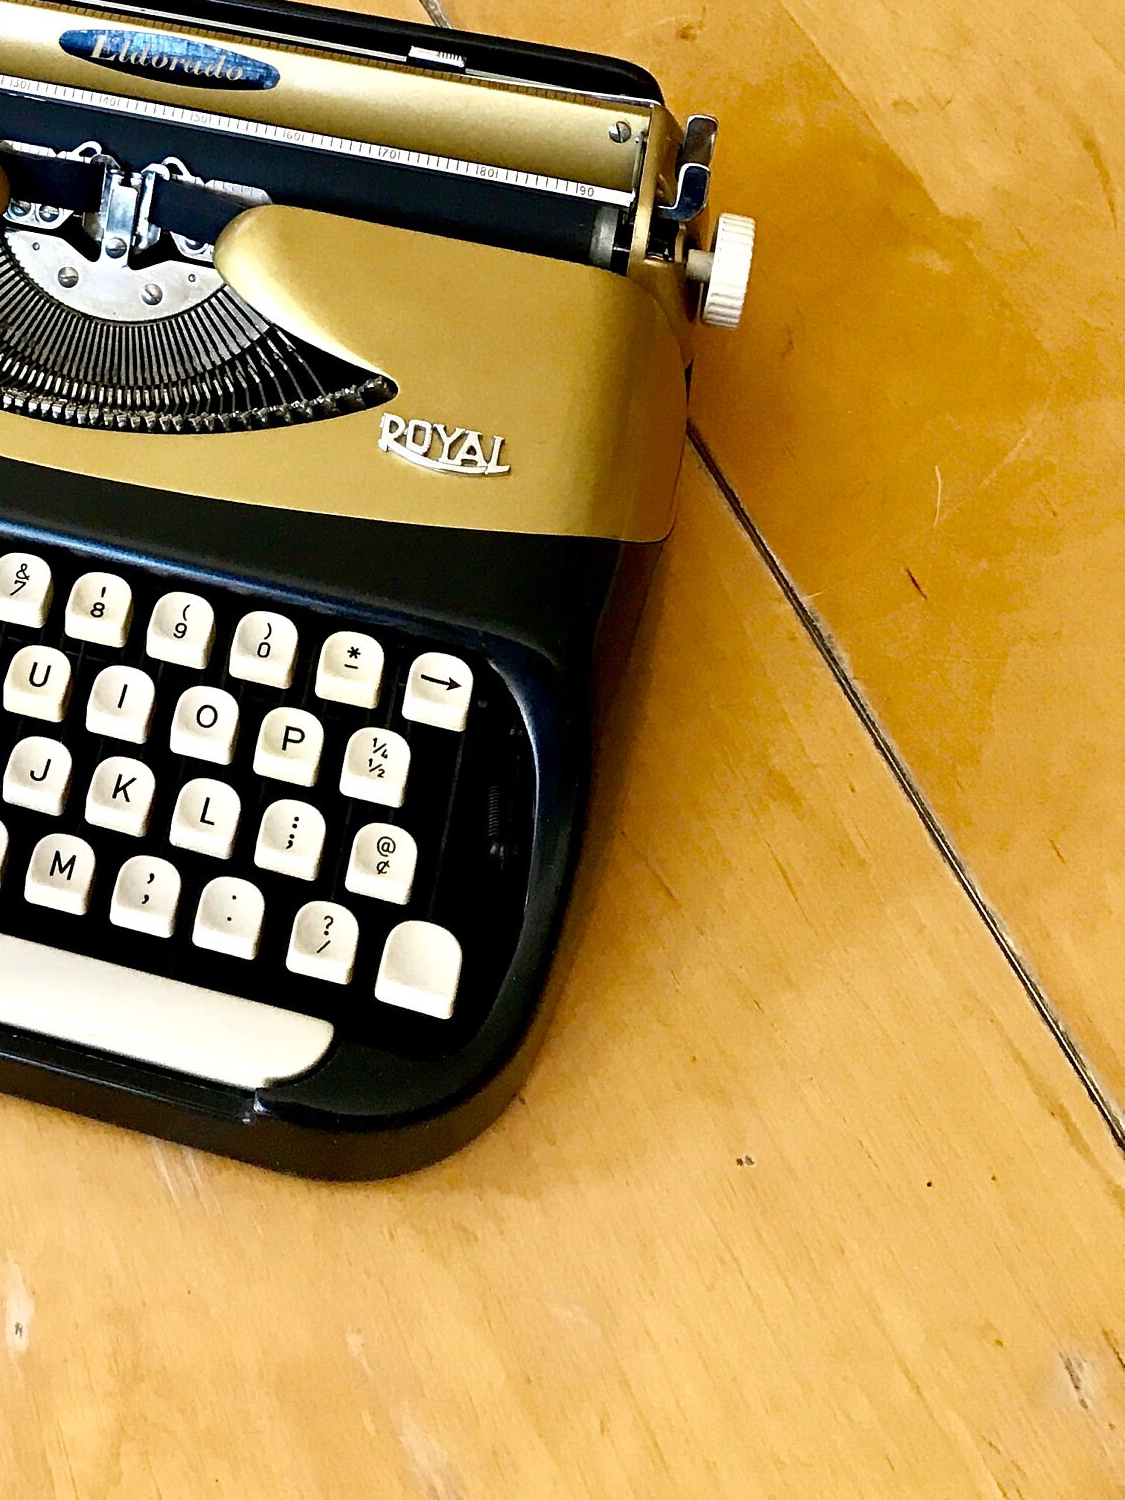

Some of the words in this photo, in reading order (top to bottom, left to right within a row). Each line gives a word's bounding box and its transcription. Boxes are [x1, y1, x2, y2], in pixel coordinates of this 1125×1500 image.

[88, 34, 244, 82] Eldorado
[378, 412, 511, 474] ROYAL
[10, 579, 28, 596] 7
[90, 602, 105, 618] 8
[174, 623, 187, 639] 9
[257, 642, 271, 658] 0
[15, 563, 30, 581] &
[182, 604, 191, 622] (
[264, 622, 273, 640] )
[29, 662, 51, 687] U
[118, 684, 128, 708] I
[196, 705, 218, 728] O
[282, 726, 305, 751] P
[30, 759, 51, 781] J
[112, 774, 137, 802] K
[200, 797, 214, 825] L
[376, 836, 396, 857] @
[50, 853, 76, 880] M
[324, 916, 333, 935] ?
[376, 860, 389, 874] ¢
